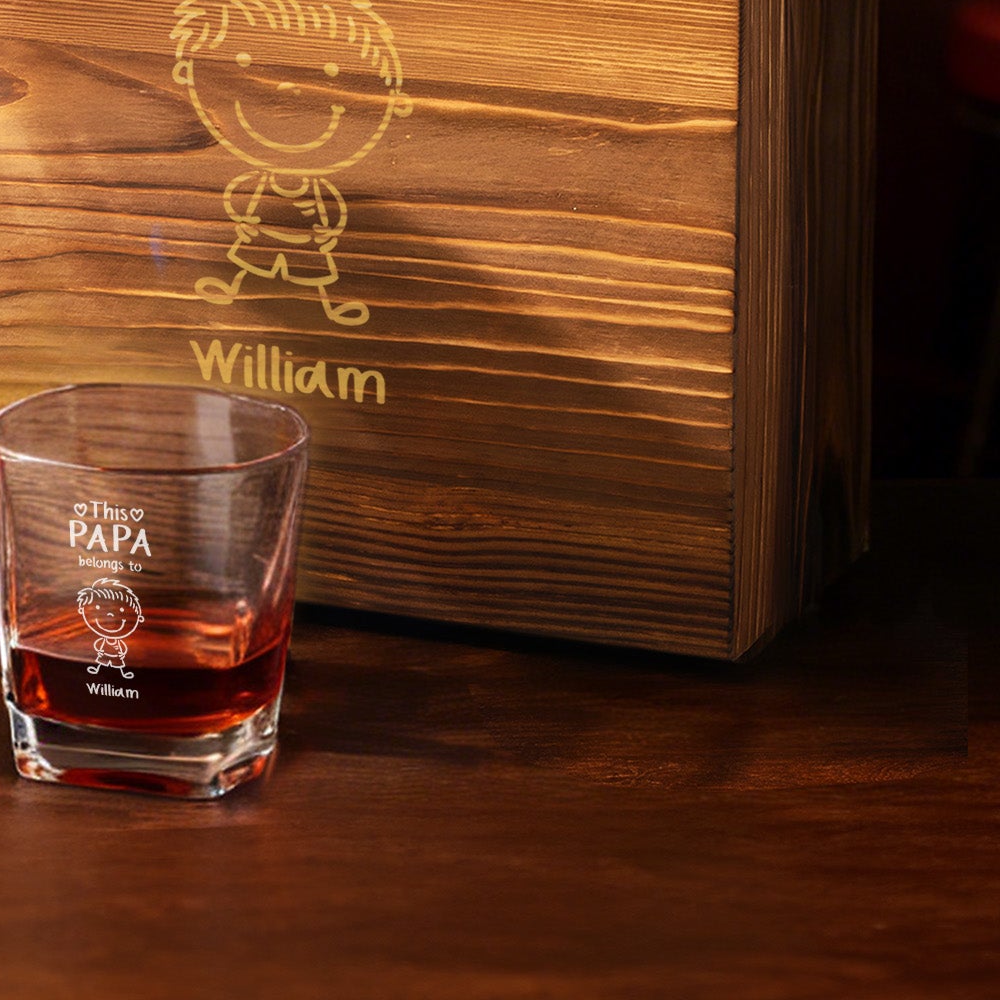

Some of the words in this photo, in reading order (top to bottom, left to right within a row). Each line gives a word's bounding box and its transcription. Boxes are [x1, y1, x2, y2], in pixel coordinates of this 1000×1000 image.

[189, 339, 386, 404] William
[89, 500, 129, 521] This
[69, 520, 152, 557] PAPA
[78, 555, 124, 574] belongs
[128, 560, 142, 572] to
[86, 682, 139, 699] William
